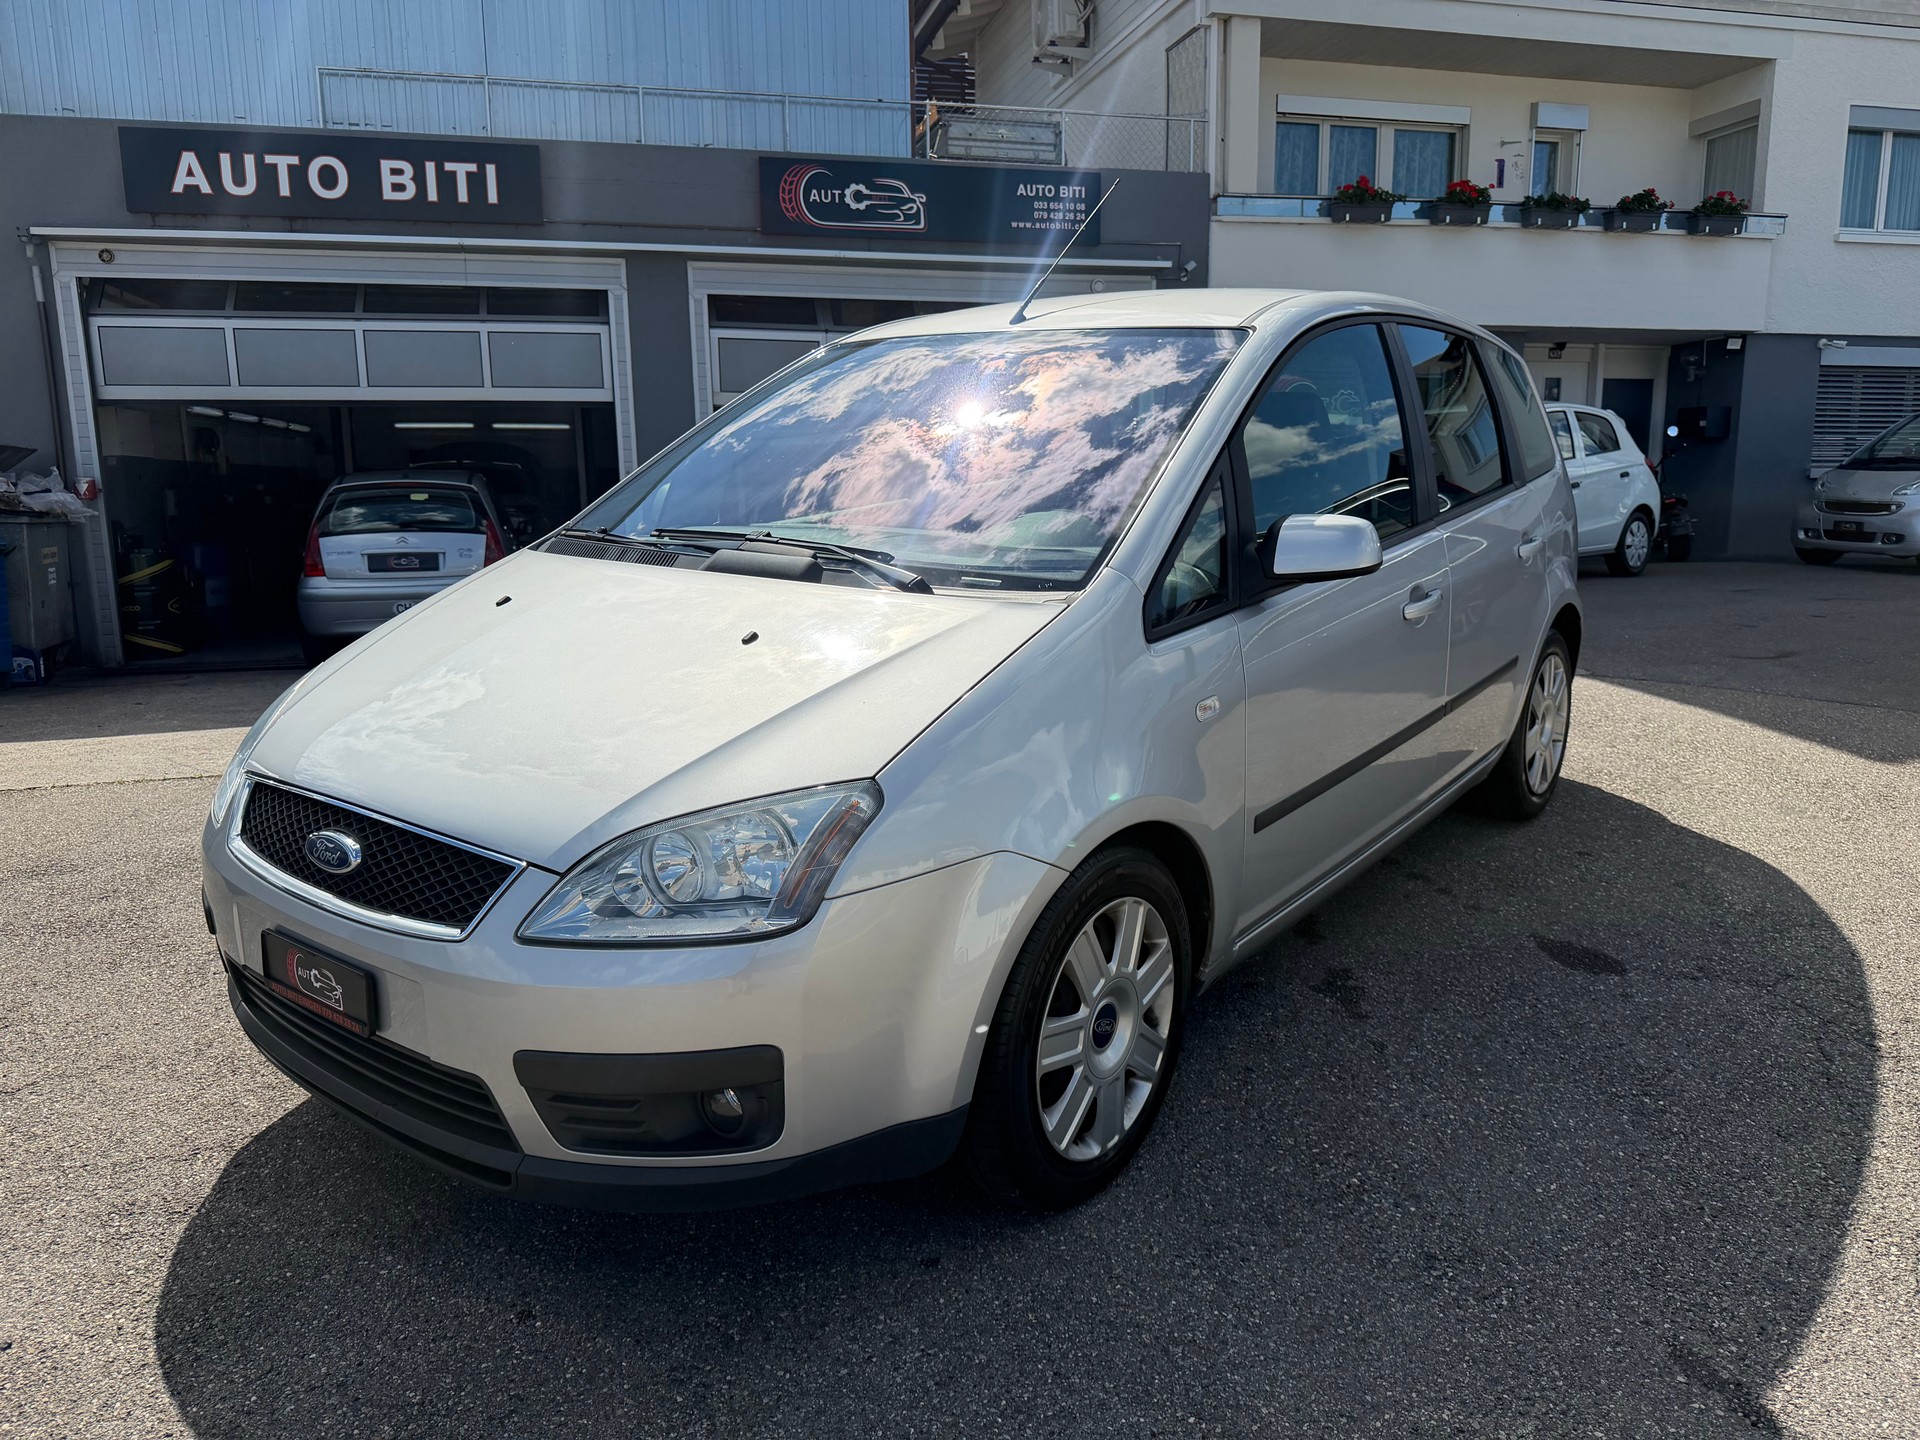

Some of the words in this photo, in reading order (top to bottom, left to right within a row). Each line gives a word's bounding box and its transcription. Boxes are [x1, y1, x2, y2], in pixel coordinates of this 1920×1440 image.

[170, 150, 349, 199] AUTO
[379, 159, 499, 204] BITI
[1016, 183, 1055, 197] AUTO
[1059, 185, 1086, 199] BITI
[1033, 201, 1048, 209] 033
[1049, 202, 1063, 210] 654
[1065, 202, 1074, 210] 10
[1076, 203, 1086, 211] 08
[1033, 211, 1048, 219] 079
[1049, 211, 1063, 220] 428
[1065, 212, 1074, 220] 26
[1076, 213, 1086, 221] 24
[313, 839, 341, 865] Ford
[271, 982, 287, 997] AUTO
